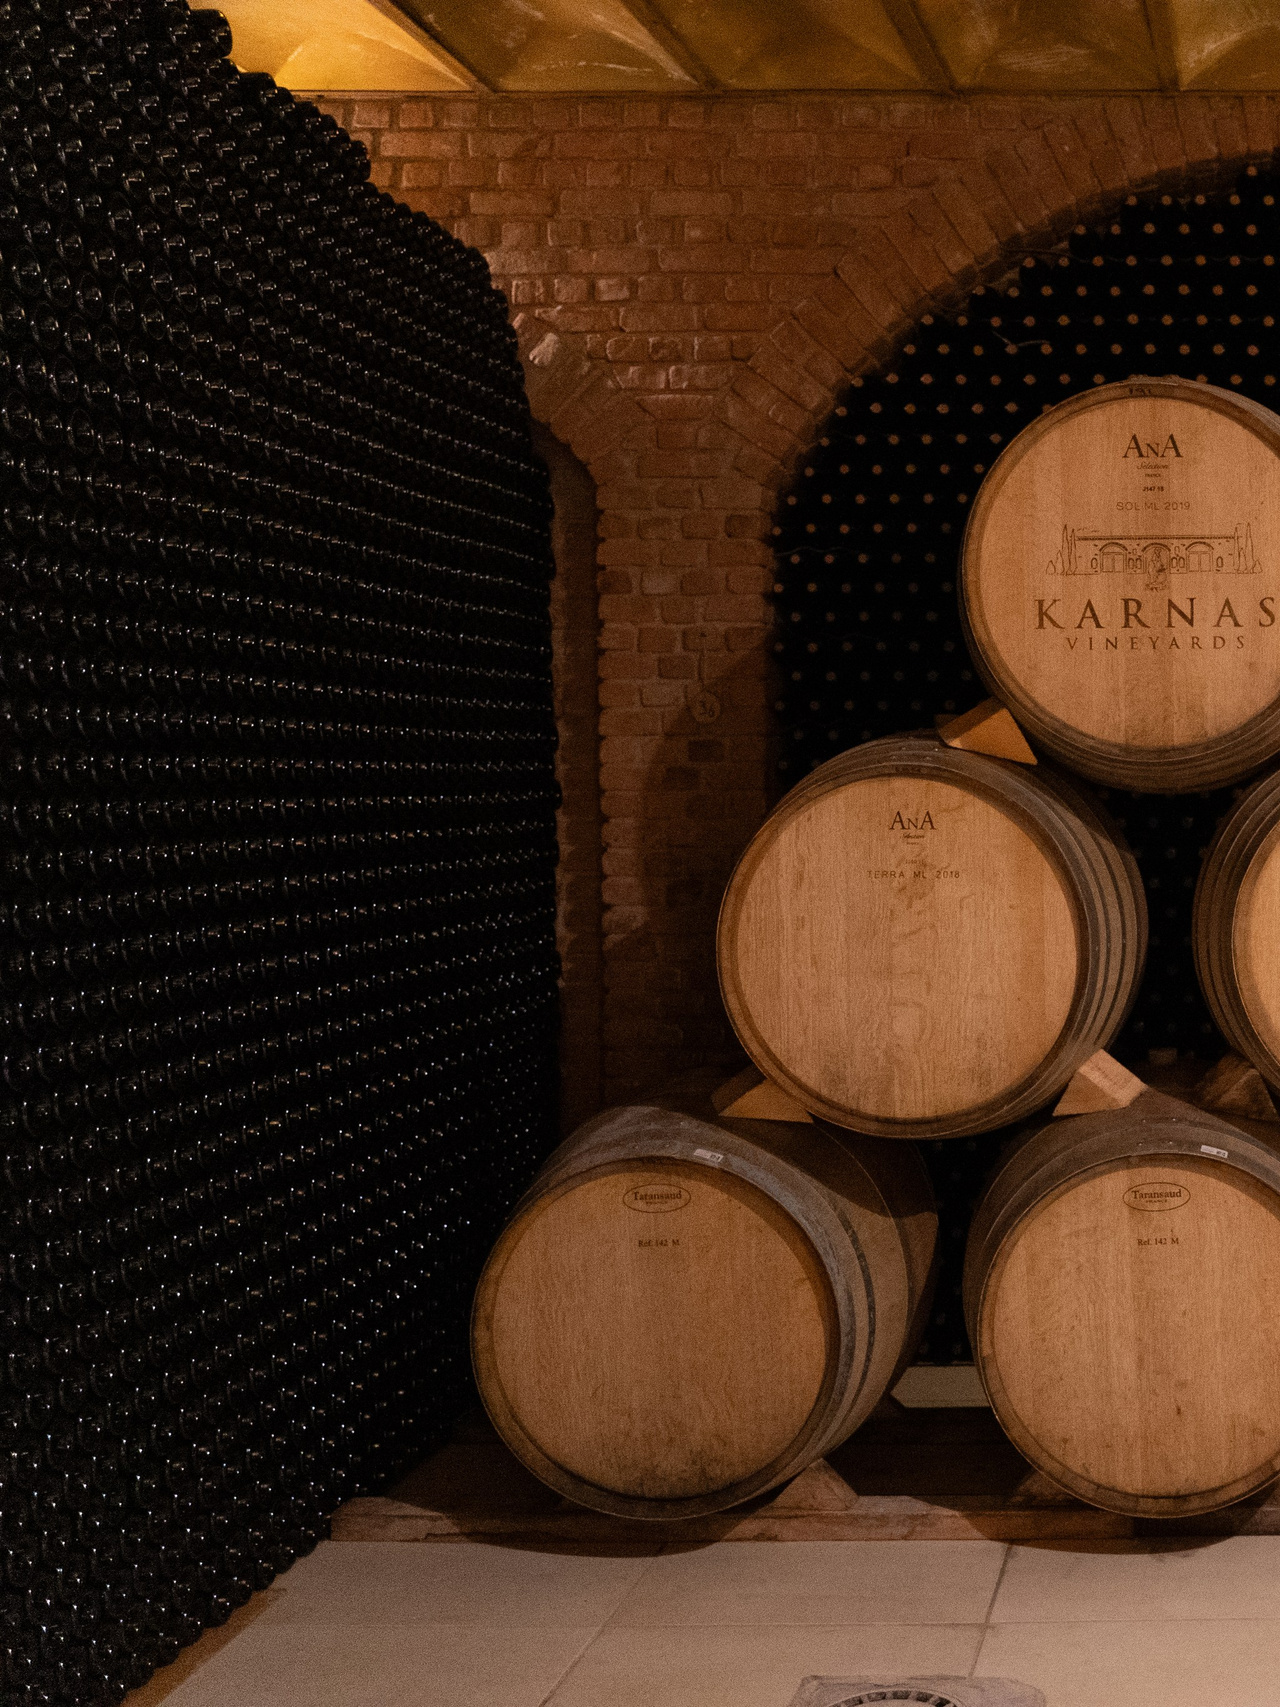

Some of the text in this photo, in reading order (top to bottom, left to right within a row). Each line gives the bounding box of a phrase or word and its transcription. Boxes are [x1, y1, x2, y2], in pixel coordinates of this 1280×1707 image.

[1116, 501, 1140, 511] SOL
[1163, 501, 1191, 511] 2019
[1034, 597, 1277, 630] KARNAS
[1066, 635, 1245, 650] VINEYARDS
[867, 870, 905, 879] TERRA
[936, 870, 960, 879] 2018
[1131, 1188, 1182, 1199] Taransaud
[1171, 1237, 1179, 1245] M
